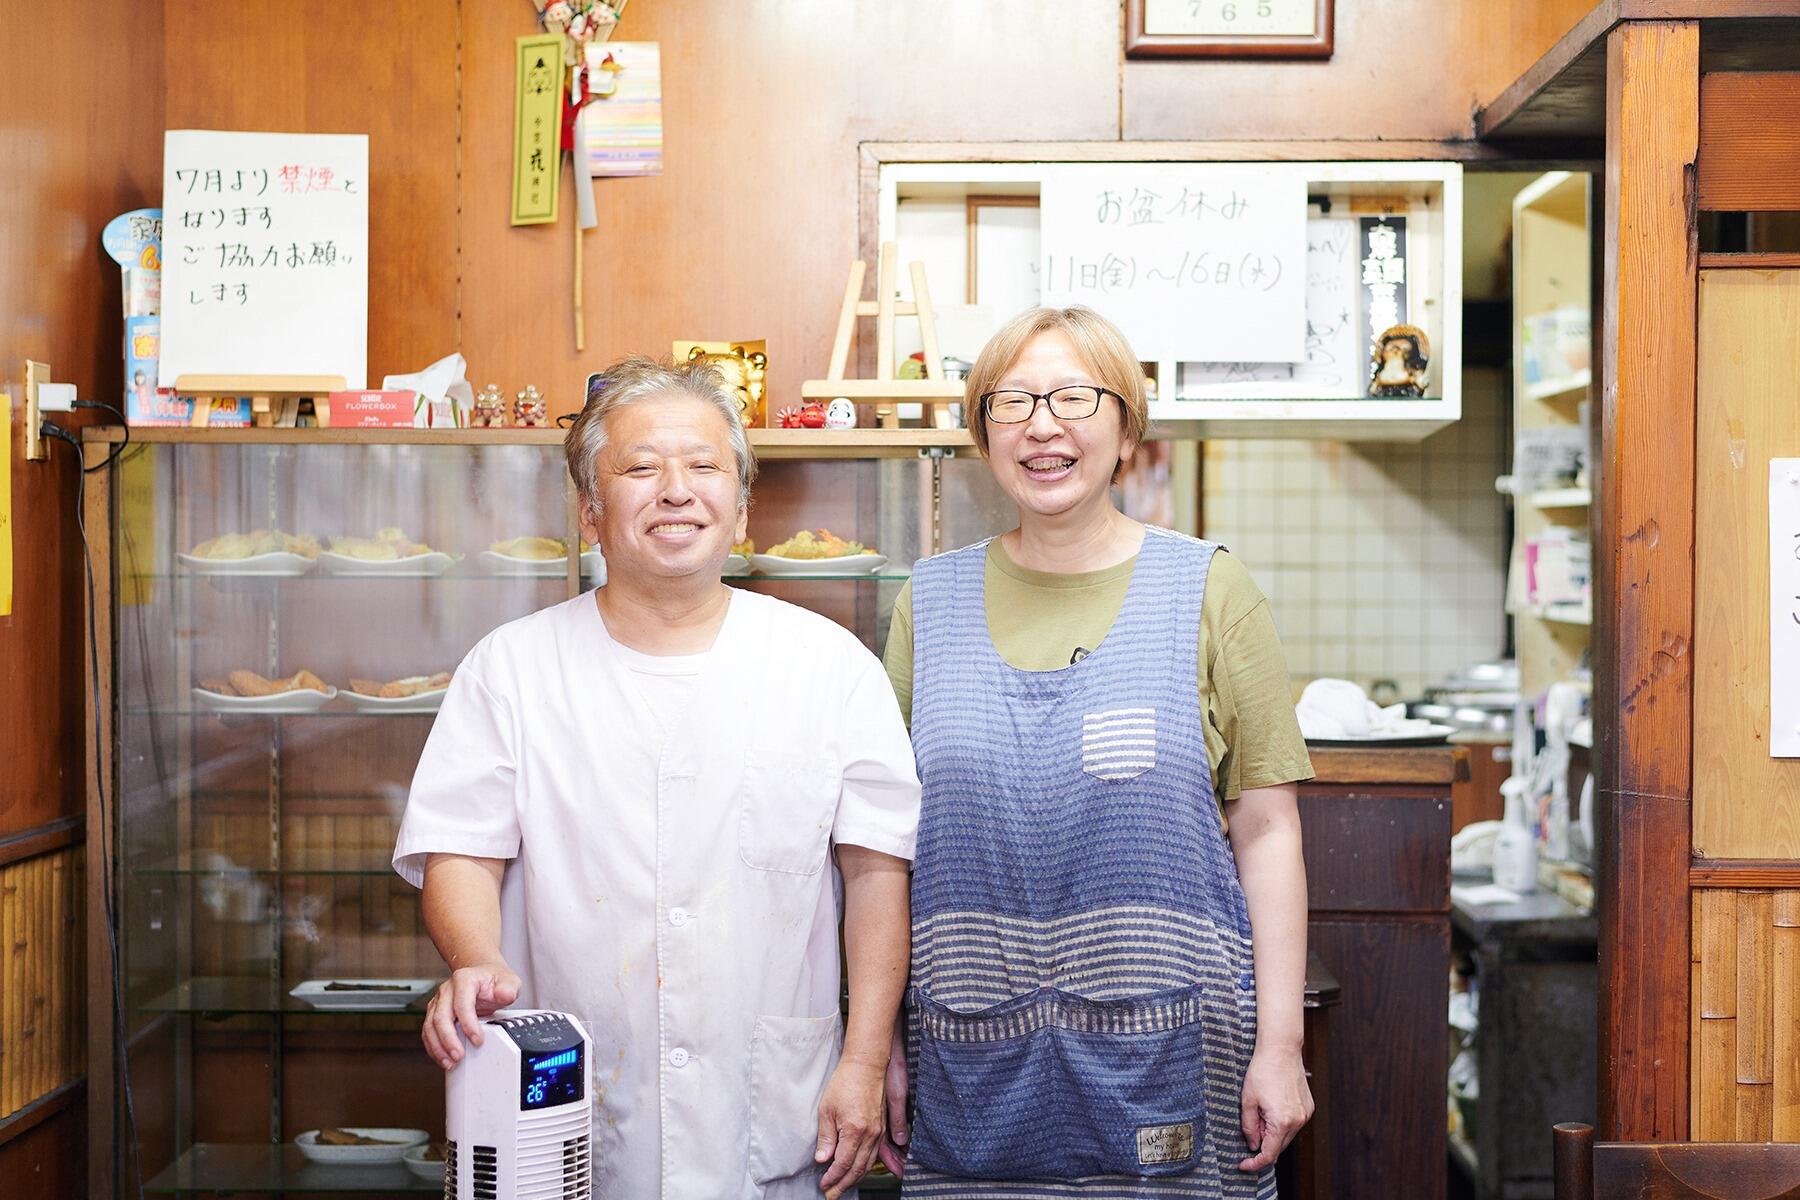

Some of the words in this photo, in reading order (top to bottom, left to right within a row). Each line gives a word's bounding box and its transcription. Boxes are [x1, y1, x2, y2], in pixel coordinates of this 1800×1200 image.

[1221, 3, 1237, 21] 6
[1256, 0, 1272, 18] 5
[179, 206, 272, 229] なります
[1096, 187, 1249, 226] お盆休み
[189, 283, 249, 305] します
